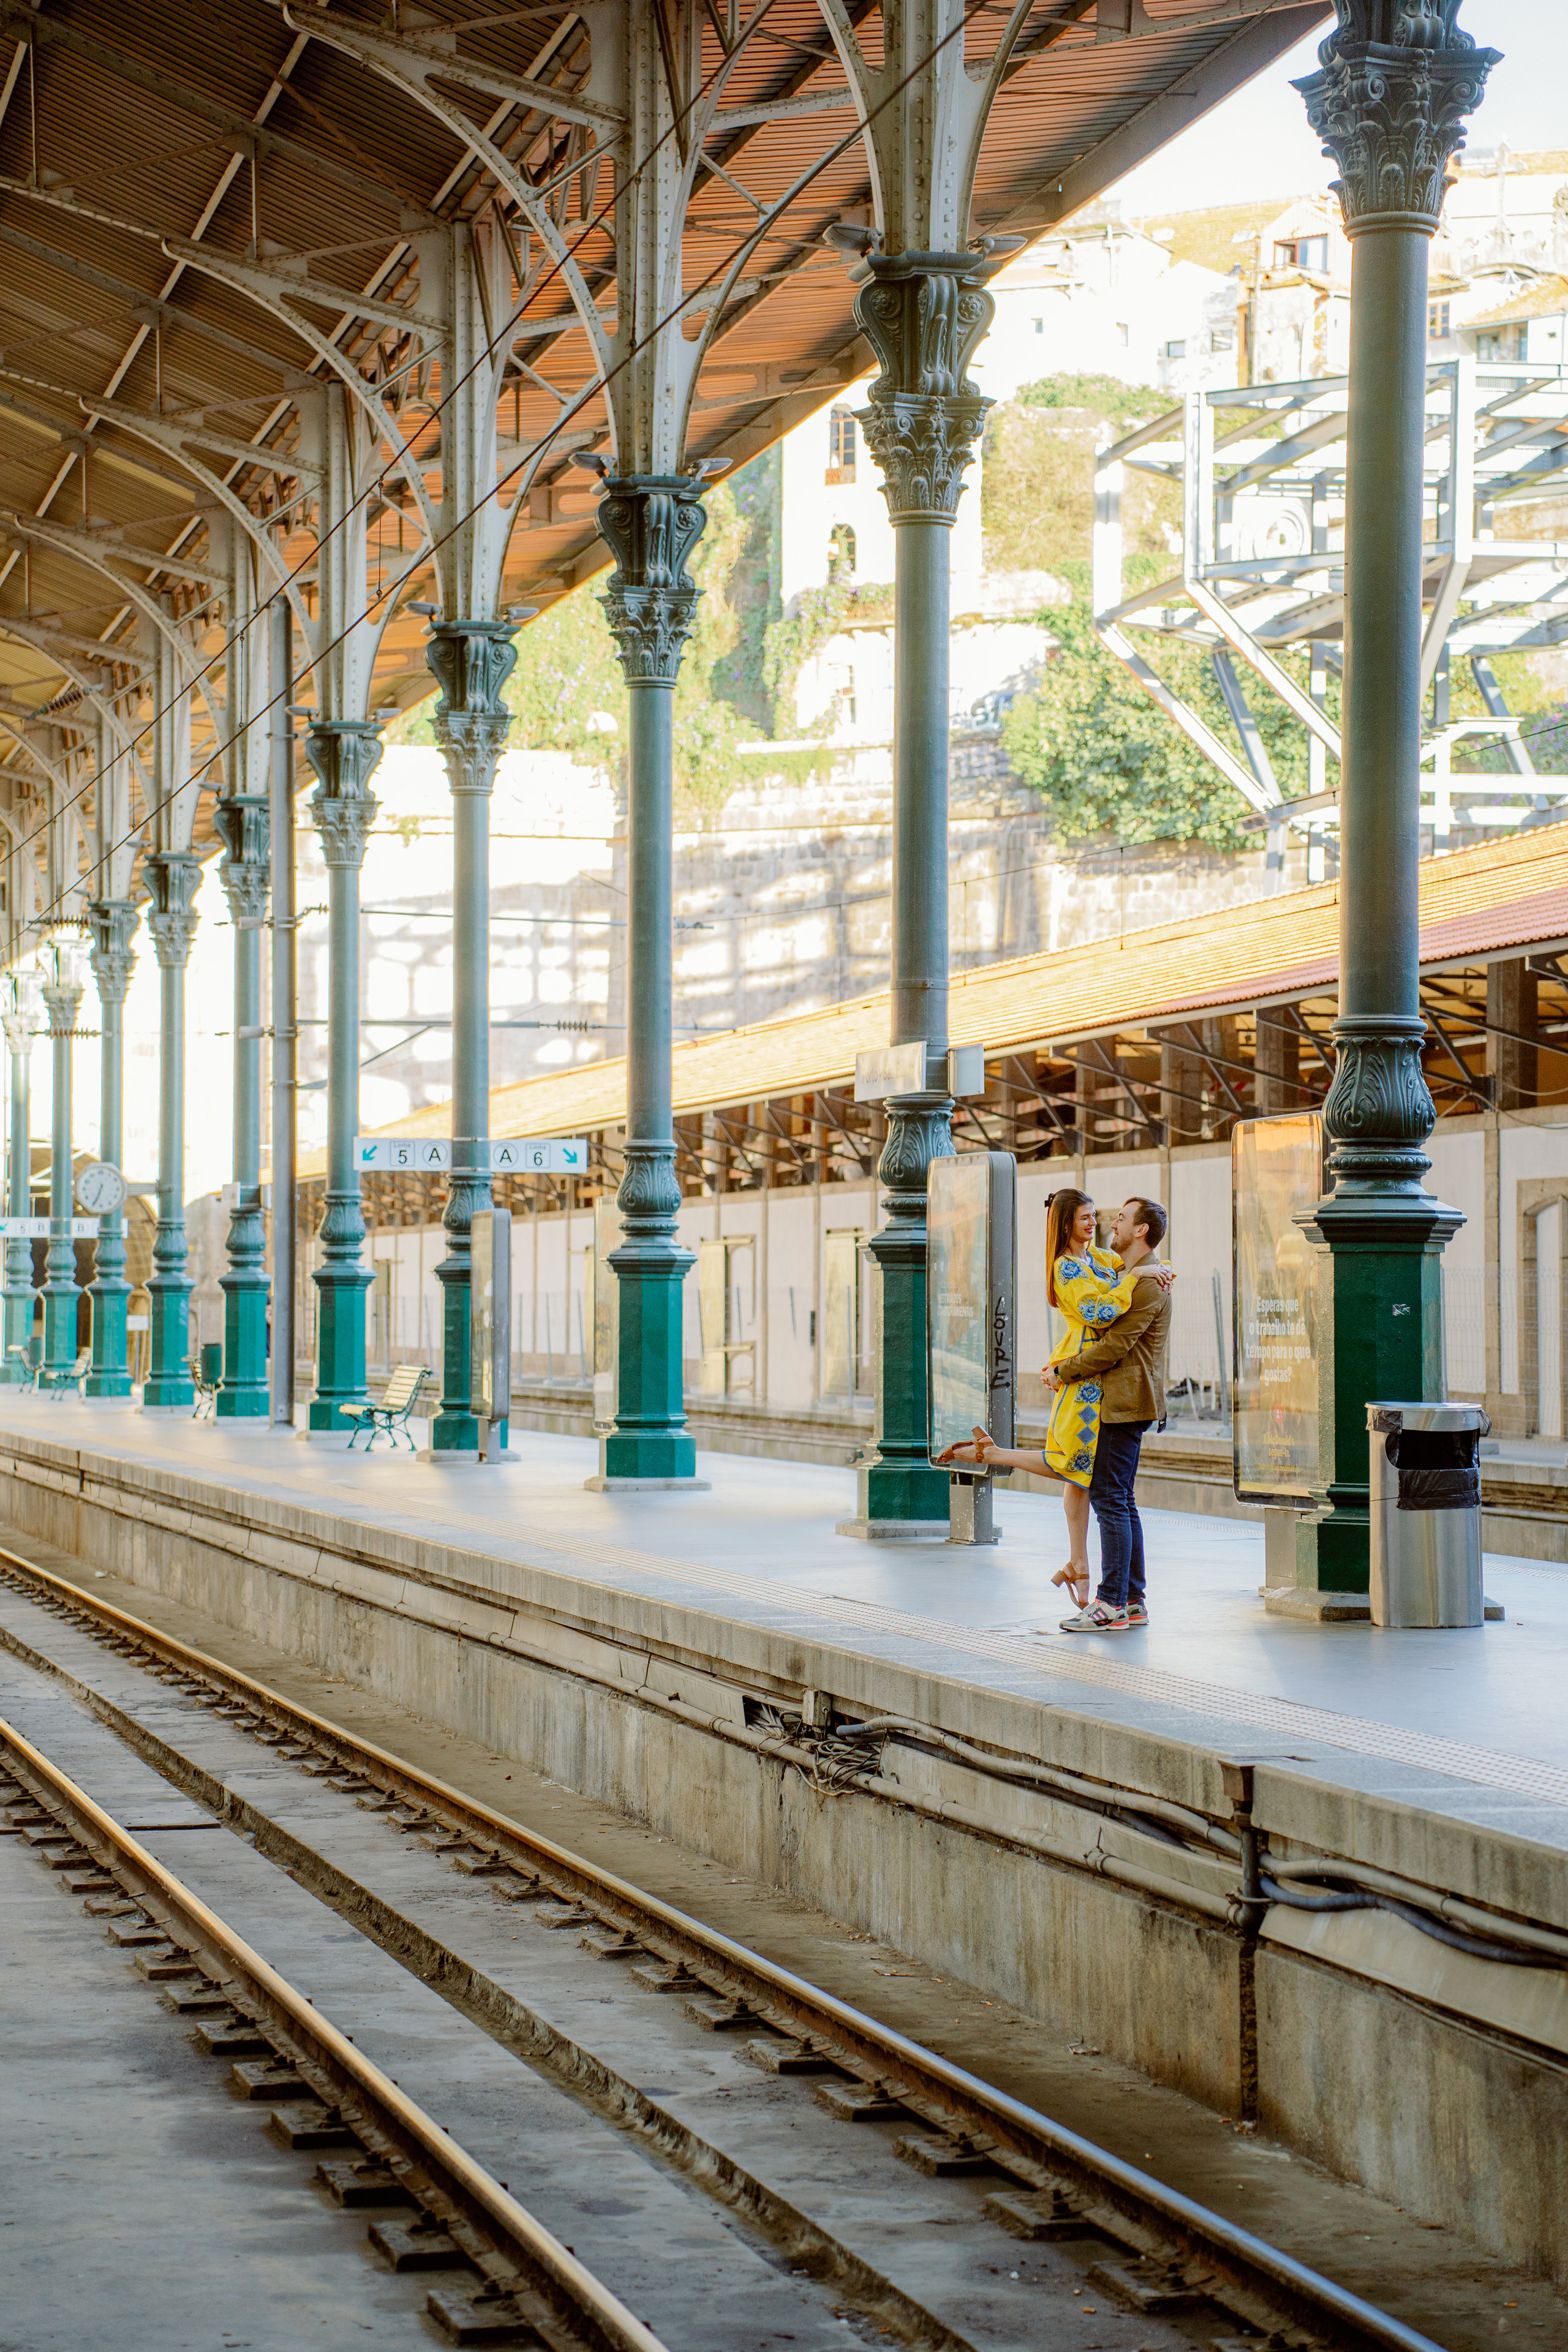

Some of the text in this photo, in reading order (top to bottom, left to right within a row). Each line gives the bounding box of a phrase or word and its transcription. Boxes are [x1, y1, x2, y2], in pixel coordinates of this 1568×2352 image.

[398, 1147, 441, 1164] 5 A
[499, 1149, 543, 1166] A 6
[1256, 1296, 1299, 1316] Esperas que
[1249, 1316, 1306, 1336] o trabalho te dê
[1245, 1343, 1311, 1363] tempo para o que
[1264, 1366, 1292, 1387] gostas?
[1263, 1434, 1295, 1446] A McDonald's
[1268, 1447, 1291, 1460] segue-te.
